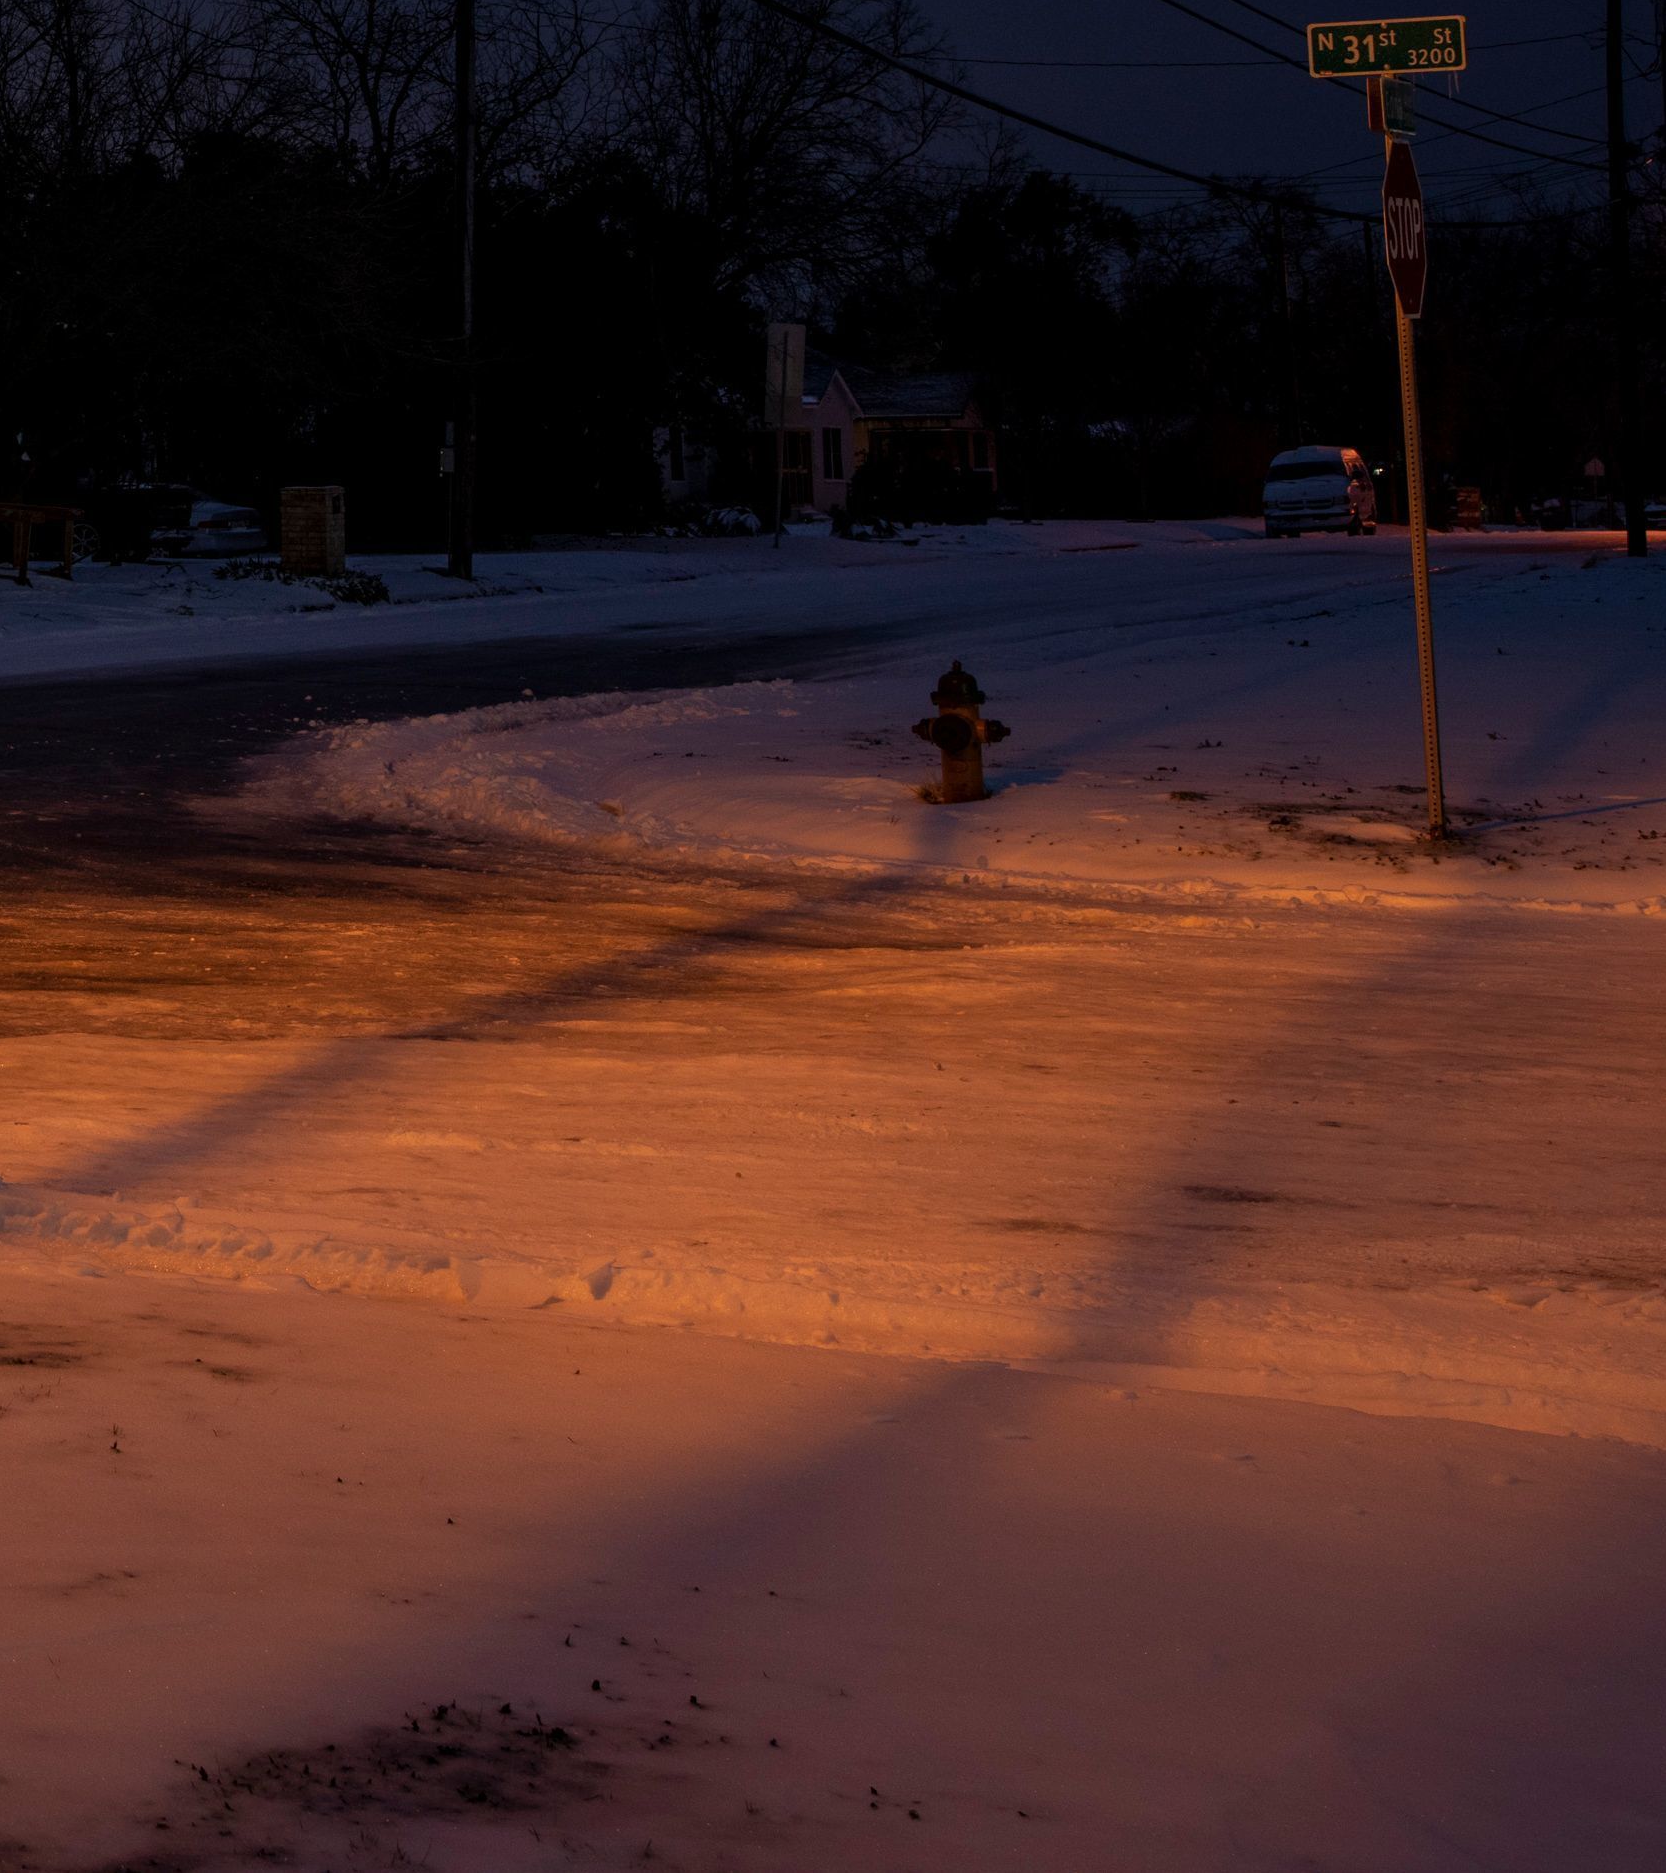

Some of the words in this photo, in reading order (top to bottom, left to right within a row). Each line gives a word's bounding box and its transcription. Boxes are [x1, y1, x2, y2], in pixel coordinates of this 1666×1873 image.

[1317, 32, 1334, 51] N
[1342, 29, 1397, 64] 31st
[1433, 28, 1453, 45] St
[1407, 47, 1456, 66] 3200
[1387, 196, 1421, 260] STOP
